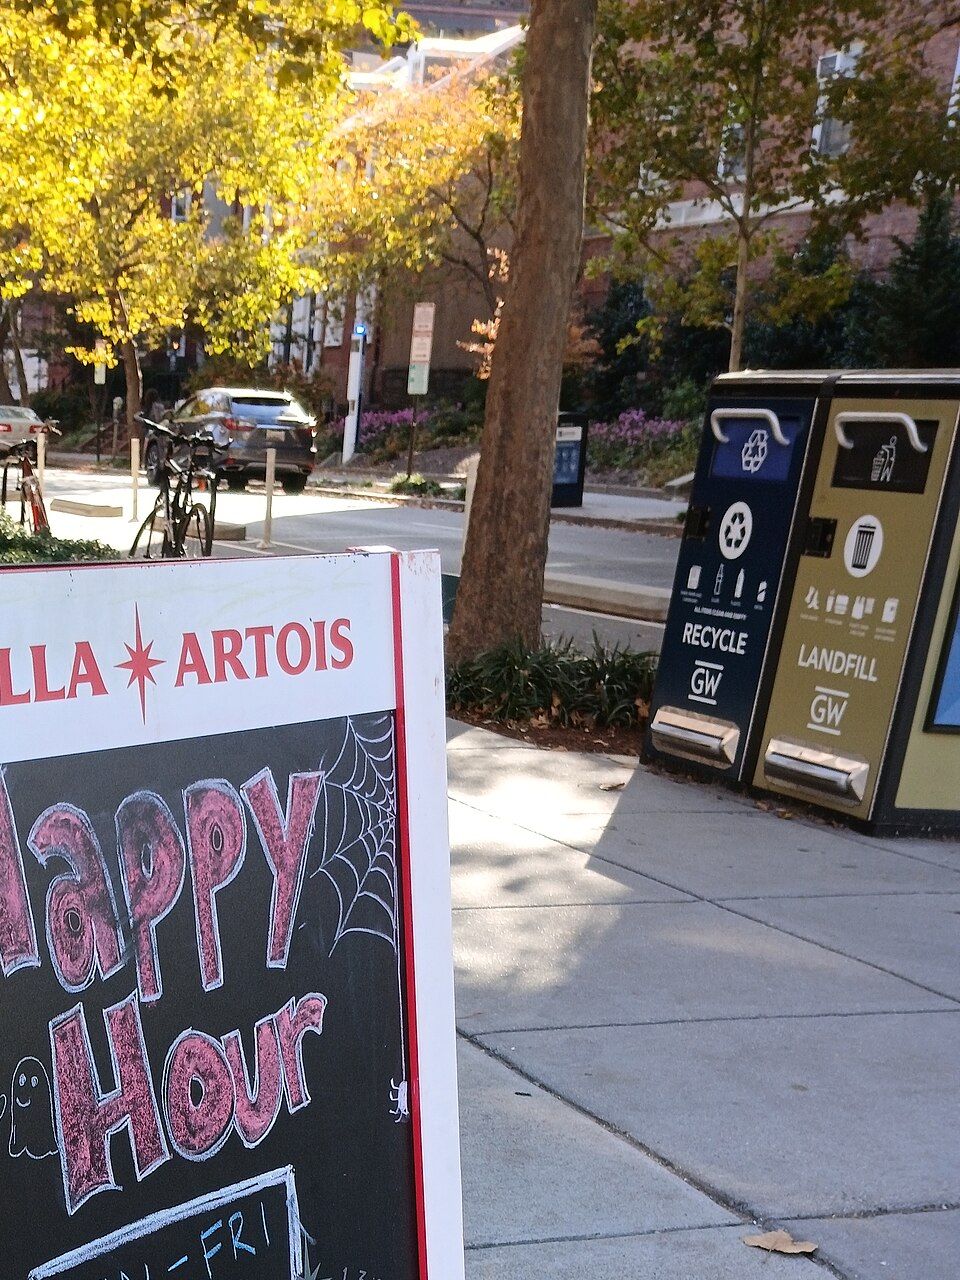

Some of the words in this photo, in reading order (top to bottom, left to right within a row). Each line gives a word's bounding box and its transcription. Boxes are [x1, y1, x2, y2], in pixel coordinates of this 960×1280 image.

[174, 618, 355, 688] ARTOIS
[682, 622, 749, 655] RECYCLE
[797, 643, 878, 682] LANDFILL
[690, 667, 723, 698] GW
[810, 694, 848, 728] GW
[200, 1201, 272, 1280] FRI
